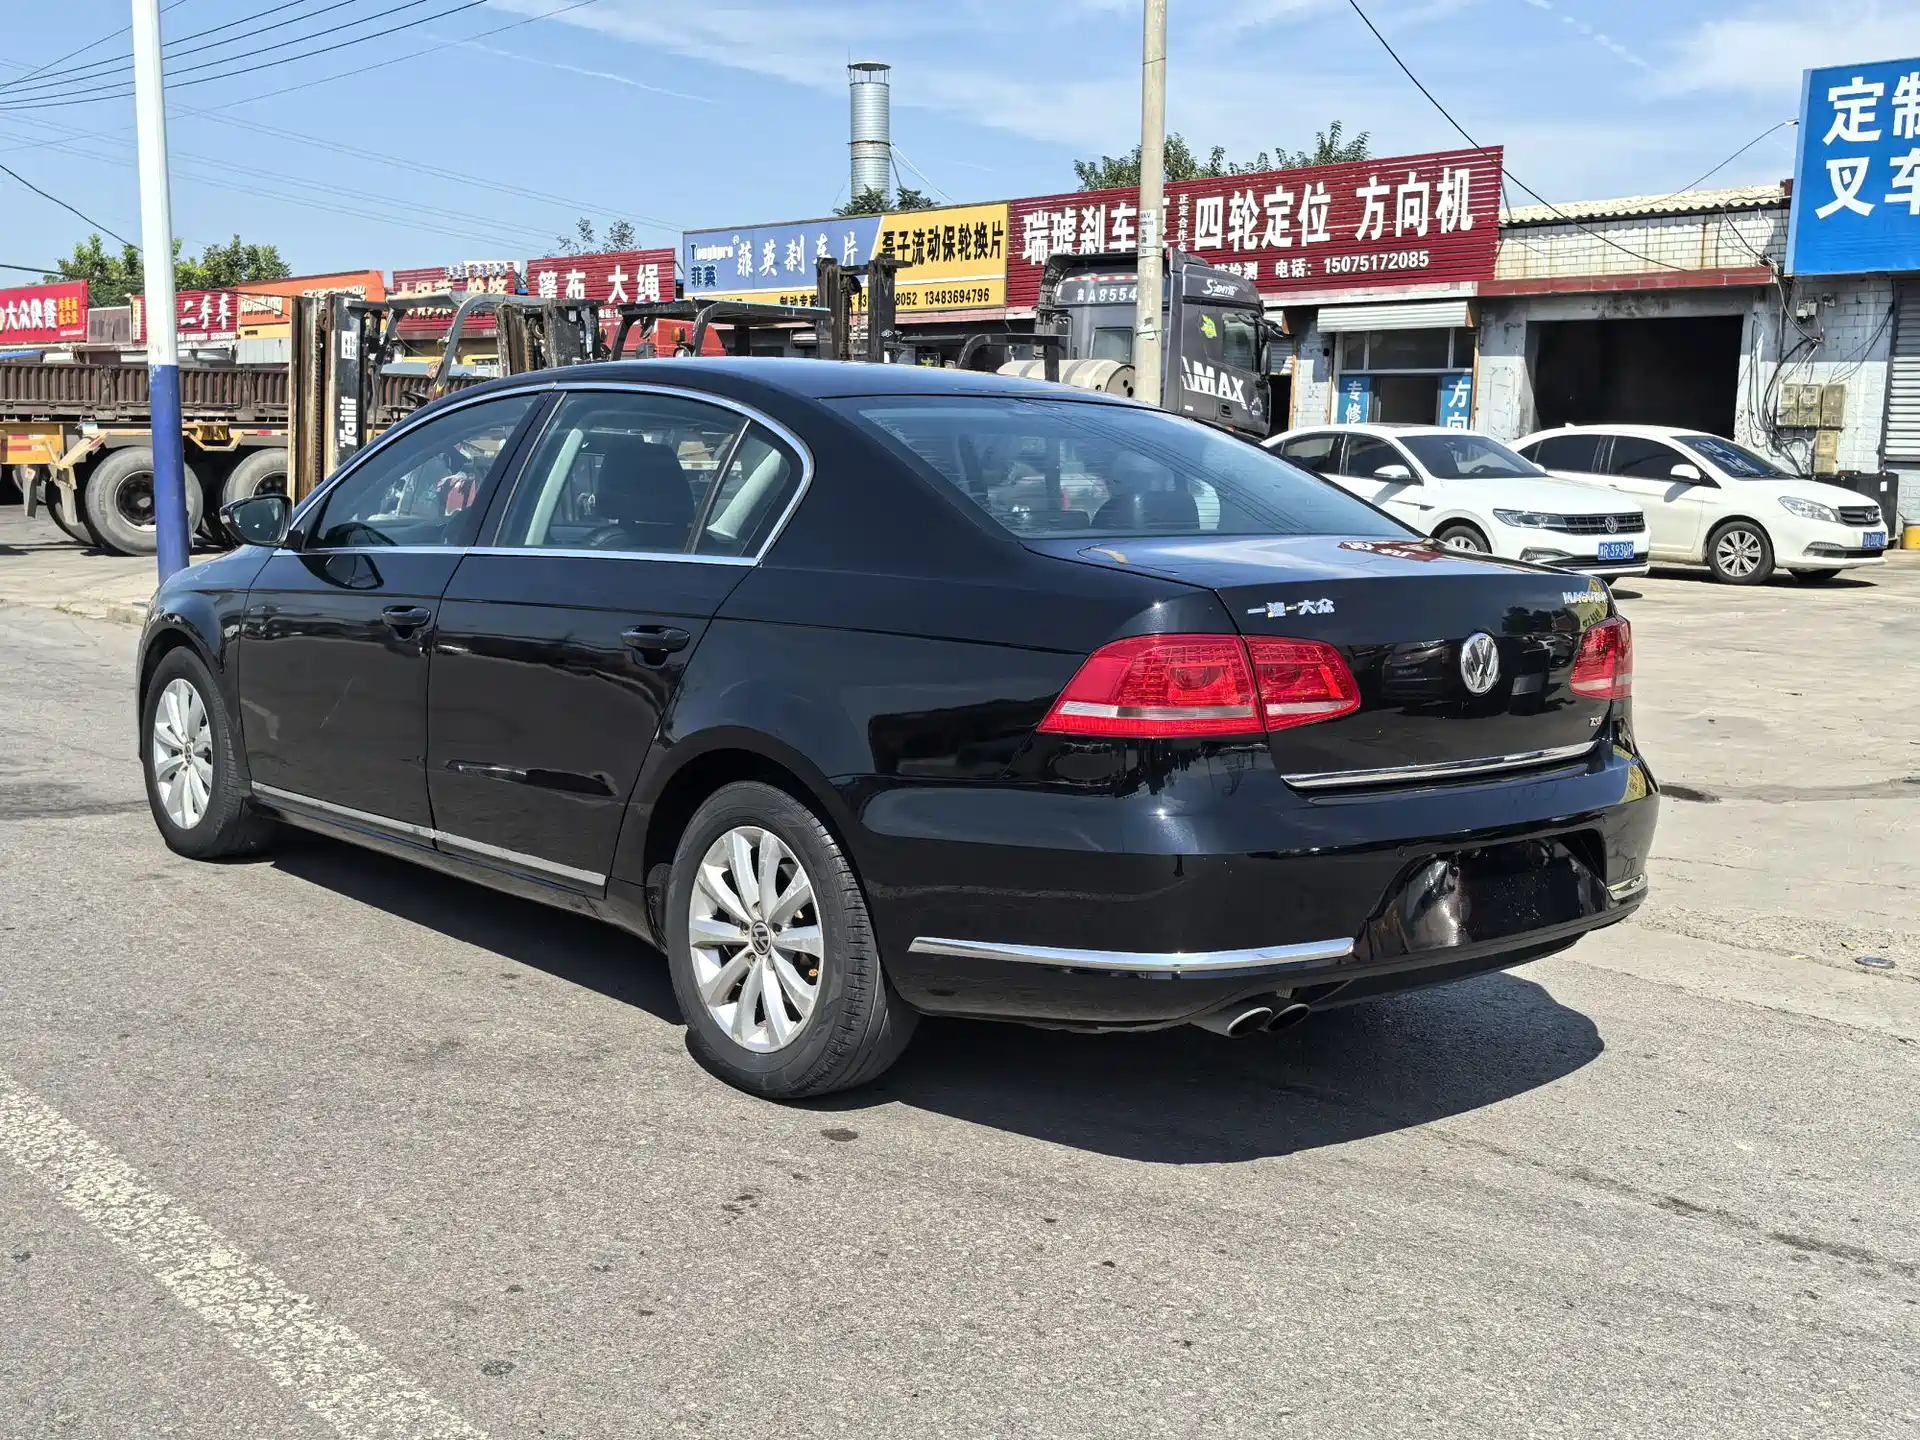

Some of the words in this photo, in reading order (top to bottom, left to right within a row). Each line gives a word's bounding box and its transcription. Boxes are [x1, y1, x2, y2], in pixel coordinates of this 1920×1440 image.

[1194, 181, 1331, 252] 四轮定位
[1355, 167, 1473, 241] 方向机
[1022, 199, 1170, 265] 瑞琥刹车
[691, 264, 718, 287] 菲英
[1324, 251, 1429, 274] 15075172085
[608, 264, 660, 303] 大绳
[925, 288, 989, 304] 13483694796
[181, 293, 232, 330] 二手车
[1345, 380, 1363, 424] 专修
[1447, 380, 1471, 430] 方向
